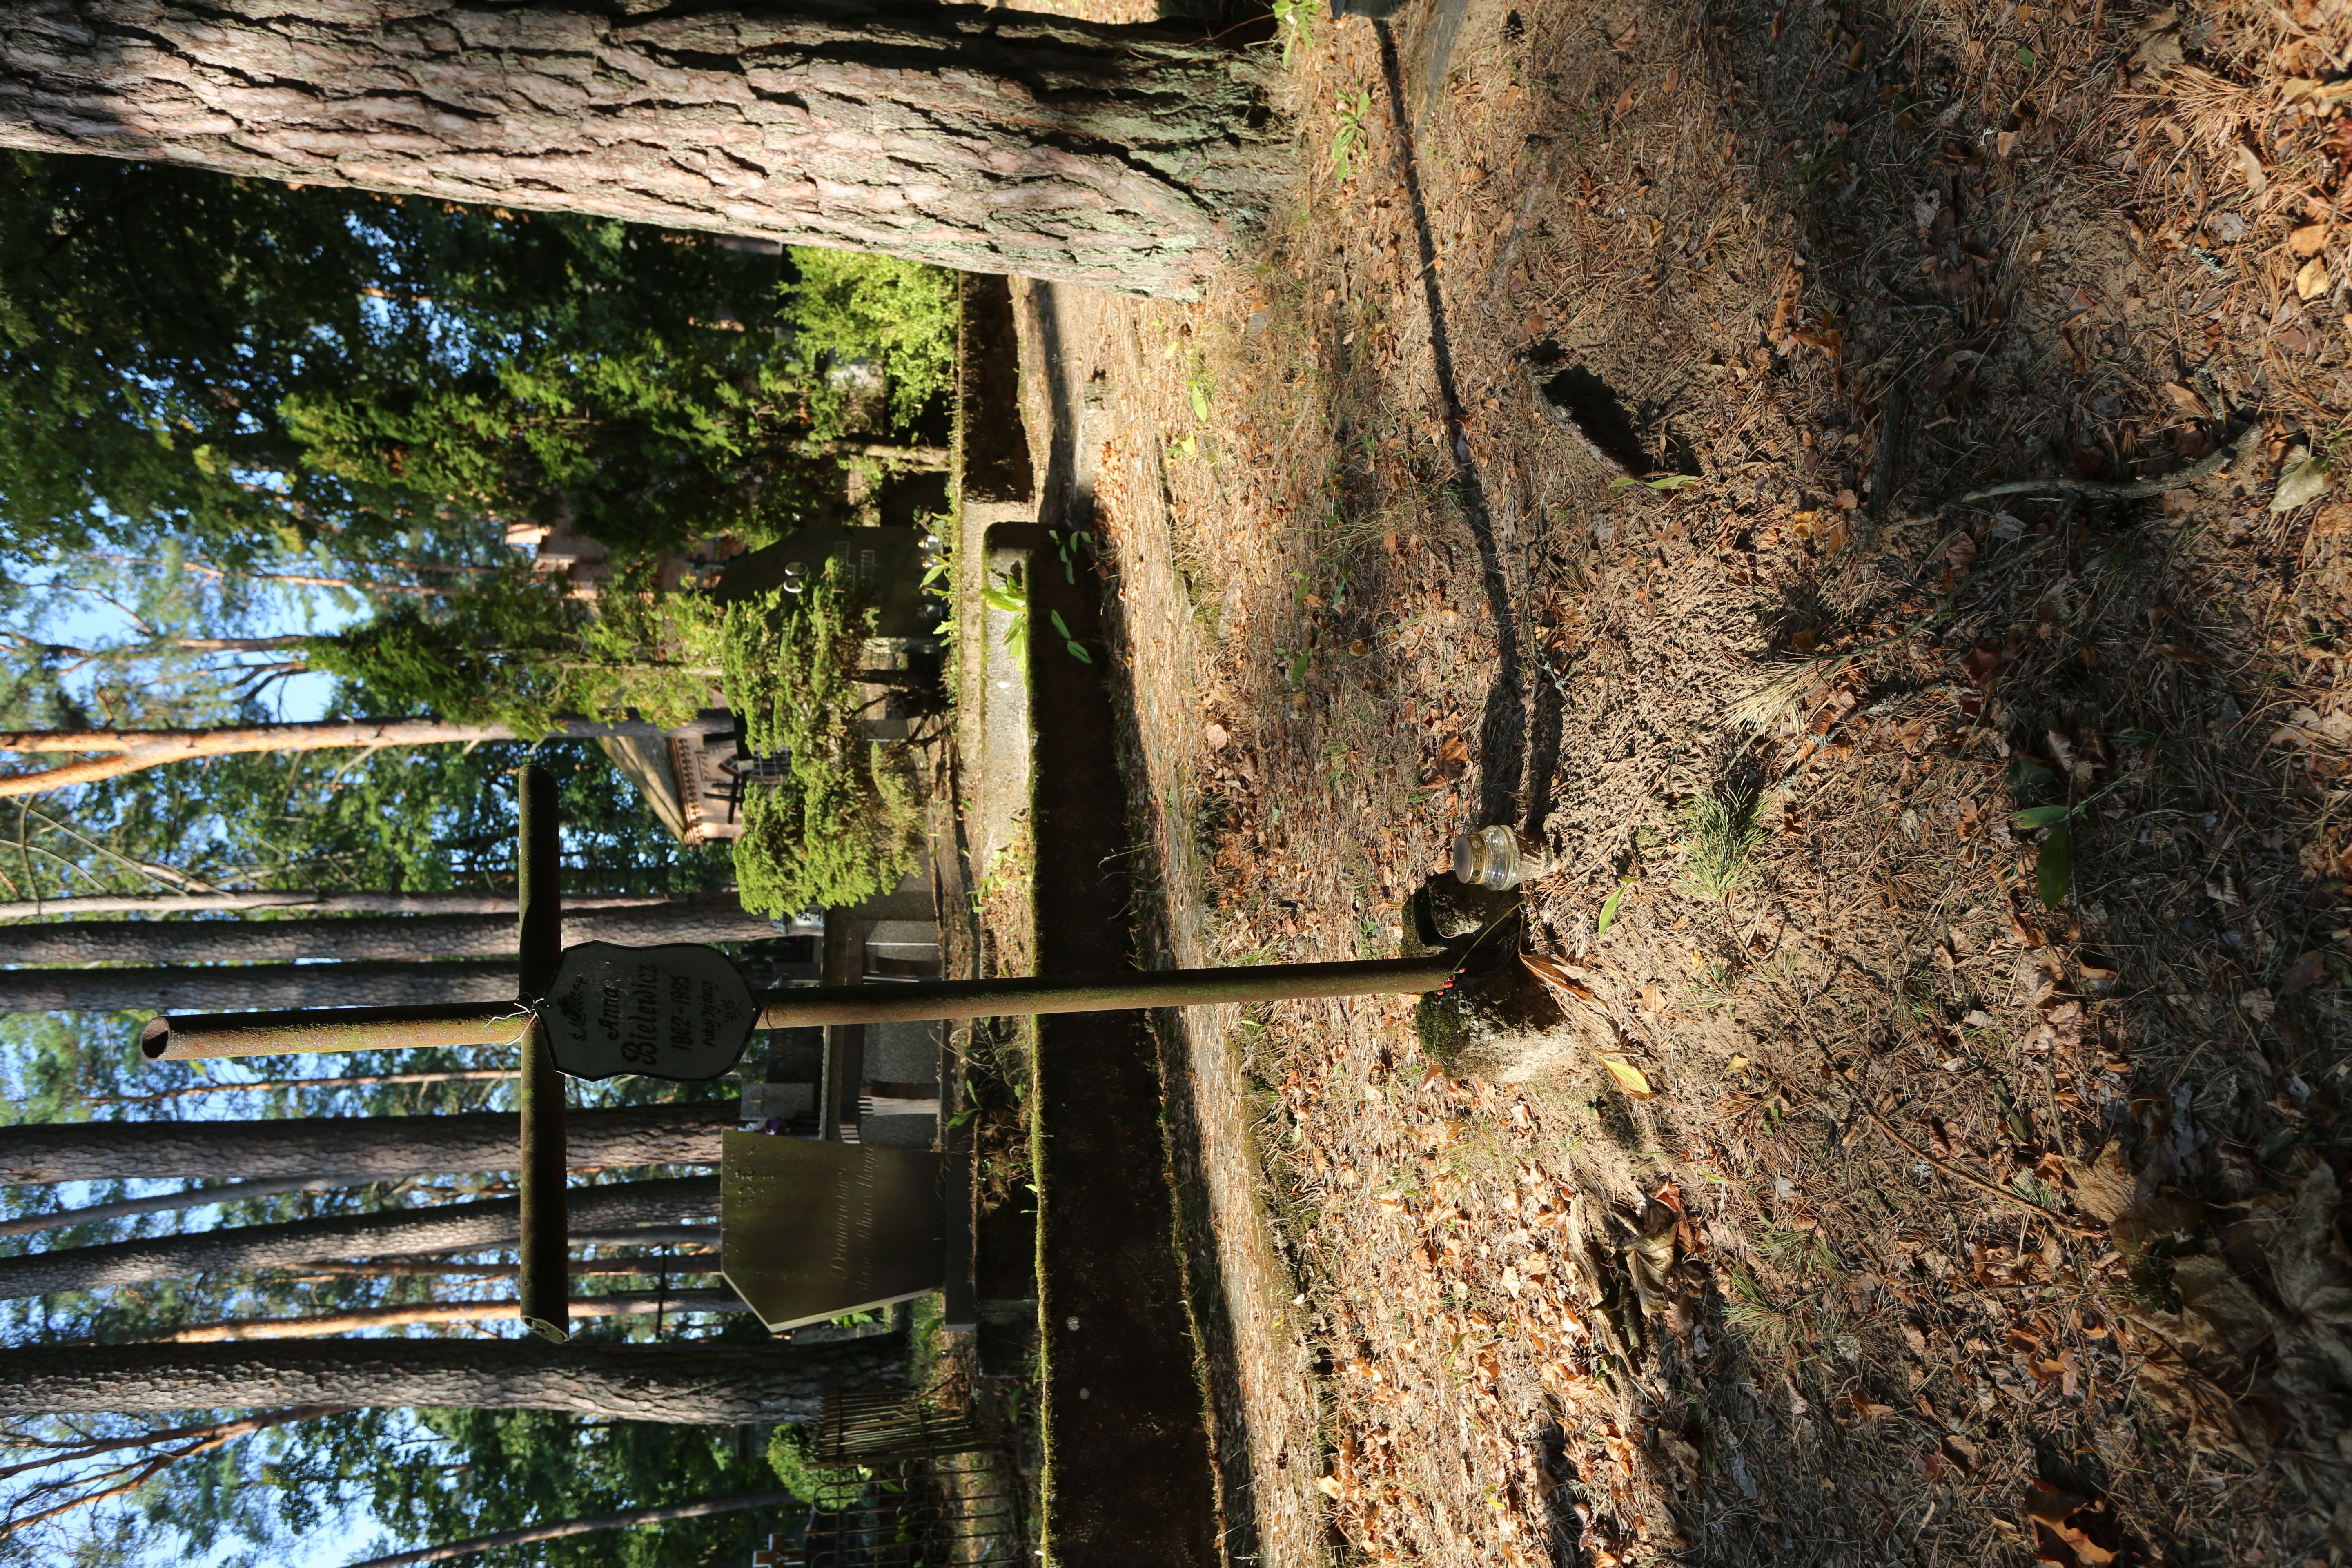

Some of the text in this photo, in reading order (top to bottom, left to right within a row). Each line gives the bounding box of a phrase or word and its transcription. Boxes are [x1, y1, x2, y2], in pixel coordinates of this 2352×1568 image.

[597, 985, 619, 1040] Anna
[621, 964, 657, 1065] Bielewicz
[697, 980, 721, 1047] Pokój Jej duszy
